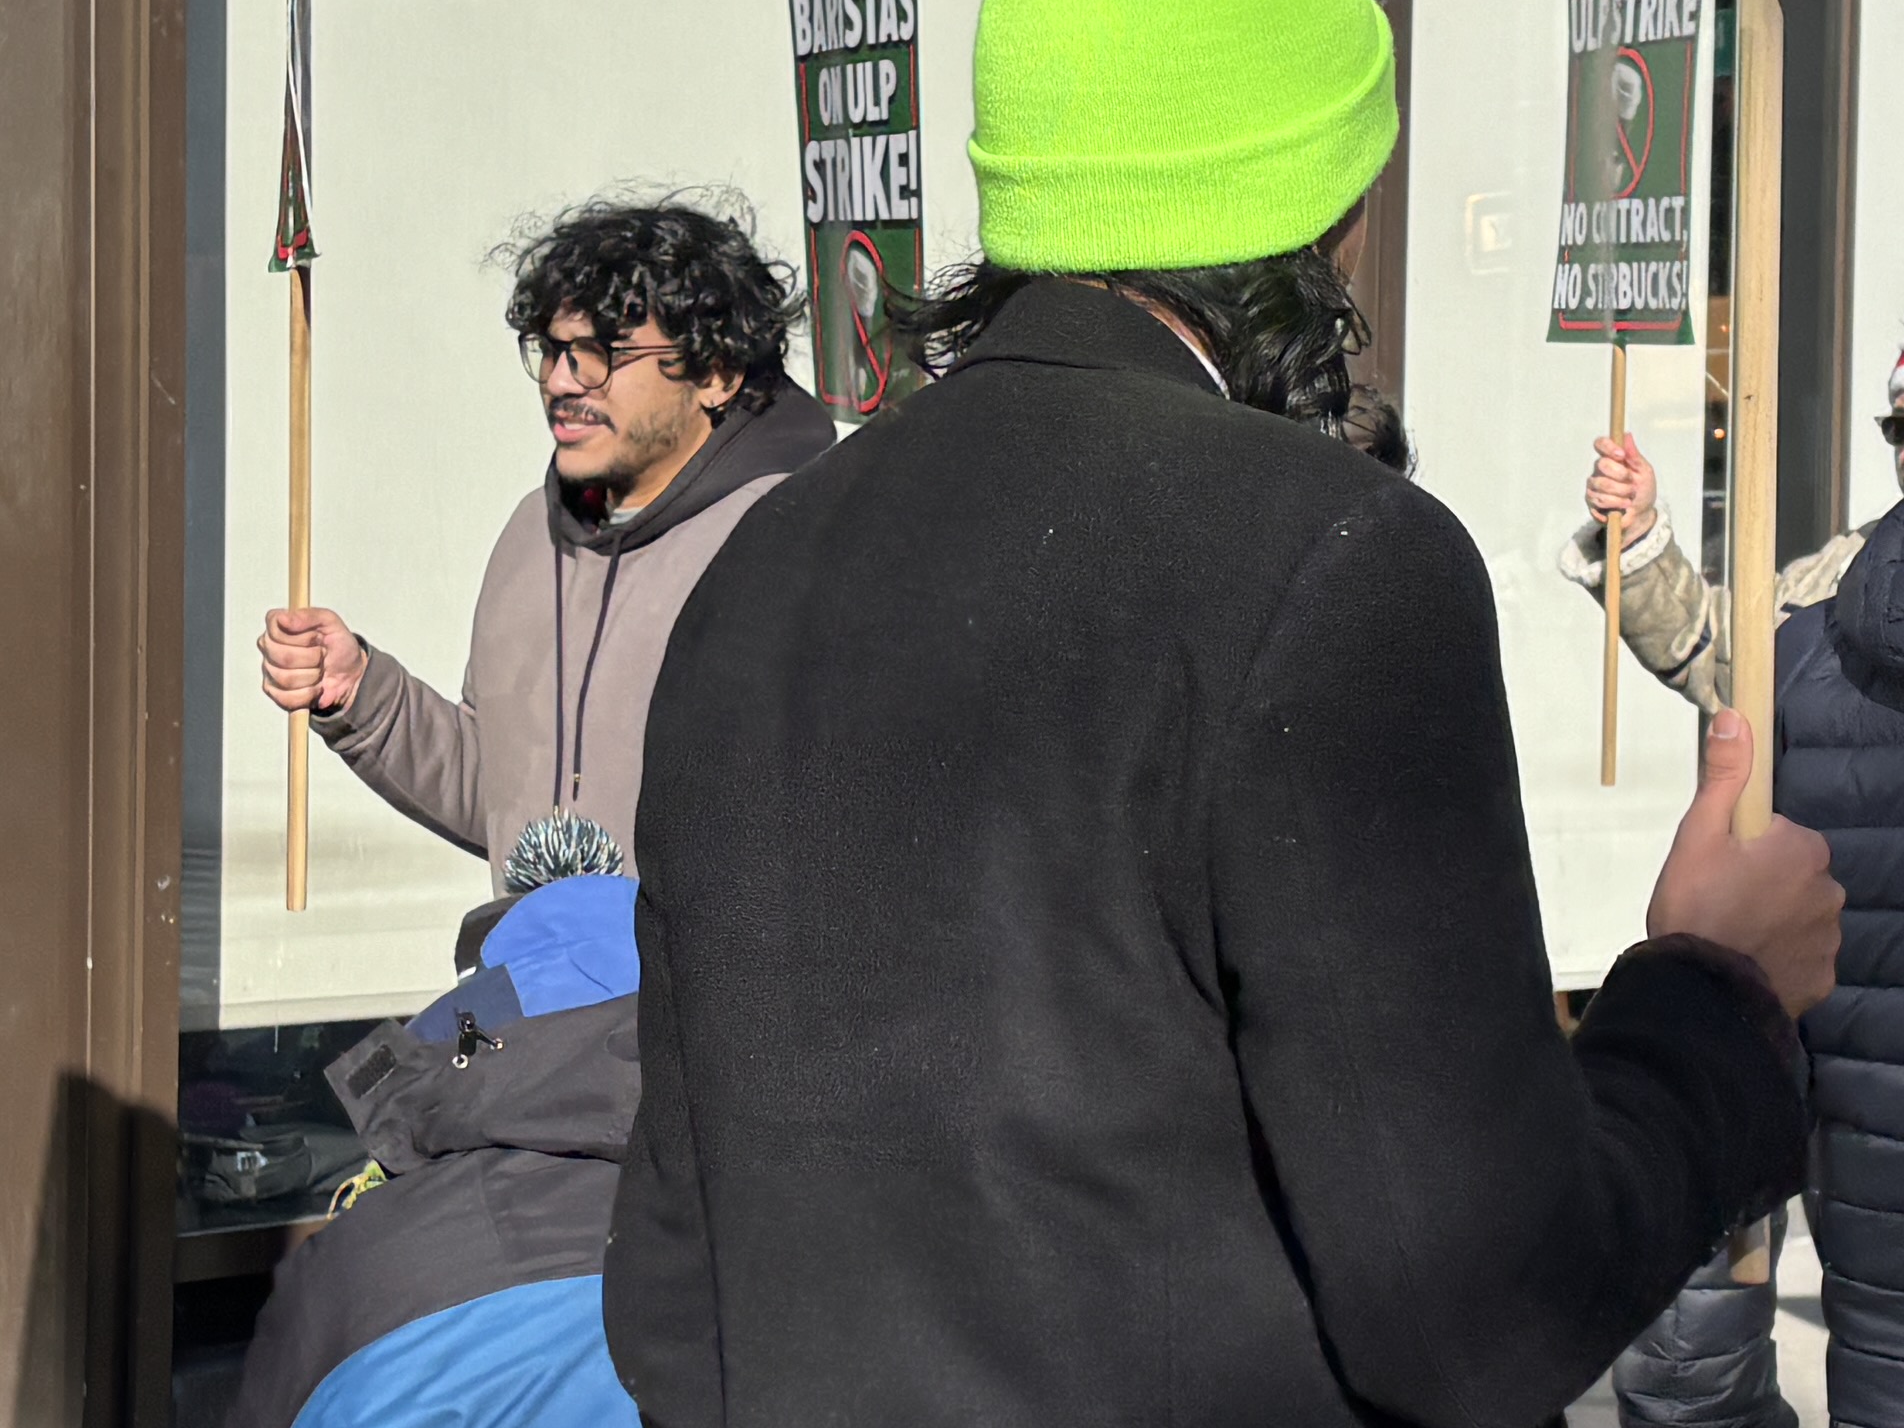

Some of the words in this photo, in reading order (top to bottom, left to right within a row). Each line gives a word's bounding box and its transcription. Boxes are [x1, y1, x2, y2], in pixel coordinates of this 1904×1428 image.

[818, 61, 844, 126] ON
[846, 59, 897, 125] ULP
[805, 130, 919, 224] STRIKE!
[1560, 202, 1587, 246] NO
[1553, 262, 1582, 310] NO
